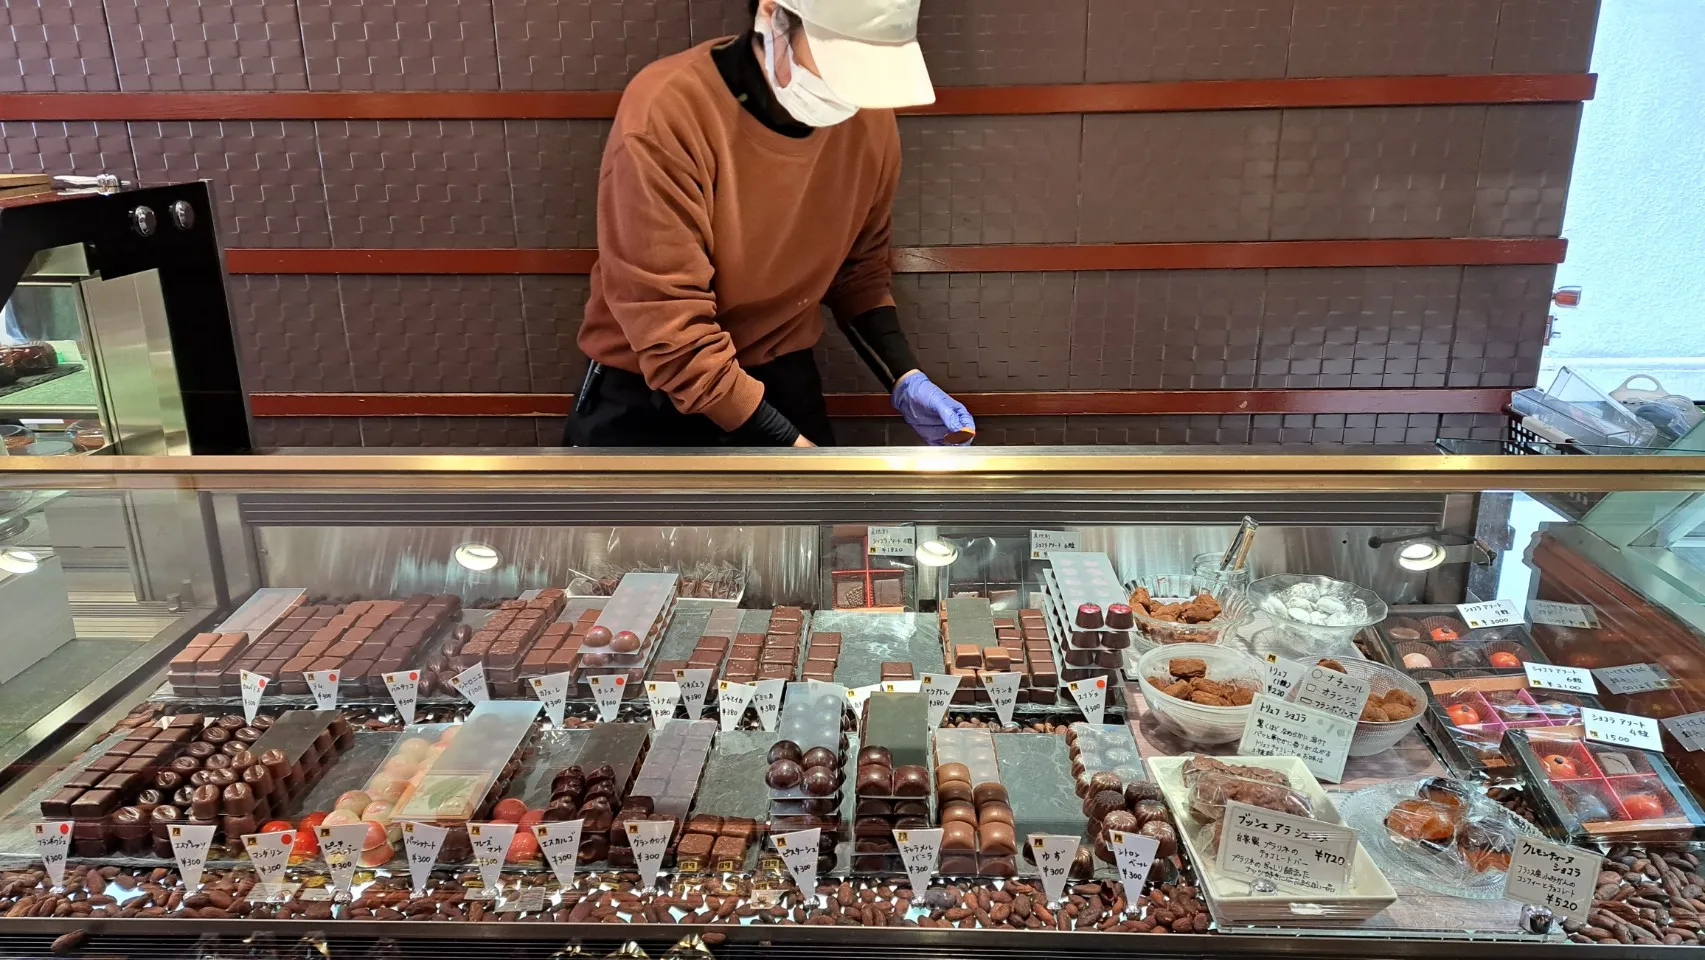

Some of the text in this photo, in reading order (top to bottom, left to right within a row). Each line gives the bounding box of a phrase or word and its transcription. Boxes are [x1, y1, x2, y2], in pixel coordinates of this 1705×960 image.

[1269, 666, 1288, 679] トリュフ
[1327, 673, 1365, 694] ナチュール
[995, 697, 1012, 707] ¥300
[1322, 687, 1357, 708] オランジュ
[1084, 703, 1101, 714] ¥300
[1259, 702, 1307, 723] トリュフ ショコラ
[1238, 813, 1269, 830] ブッシェ
[542, 831, 576, 848] エスカルゴ
[903, 844, 933, 854] キャラメル
[1042, 849, 1066, 862] ゆず
[1522, 841, 1575, 865] クレモンティーヌ
[45, 854, 63, 864] ¥300
[180, 857, 201, 867] ¥300
[411, 853, 431, 864] ¥300
[479, 857, 498, 867] ¥300
[551, 853, 572, 867] ¥300
[637, 853, 660, 862] ¥300
[912, 852, 933, 863] バニラ
[1314, 848, 1346, 867] ¥720
[259, 863, 281, 876] ¥300
[793, 864, 811, 875] ¥300
[908, 865, 929, 876] ¥300
[1042, 865, 1065, 877] ¥300
[1122, 868, 1142, 881] ¥300
[1552, 863, 1582, 878] ショコラ
[1545, 893, 1579, 912] ¥520
